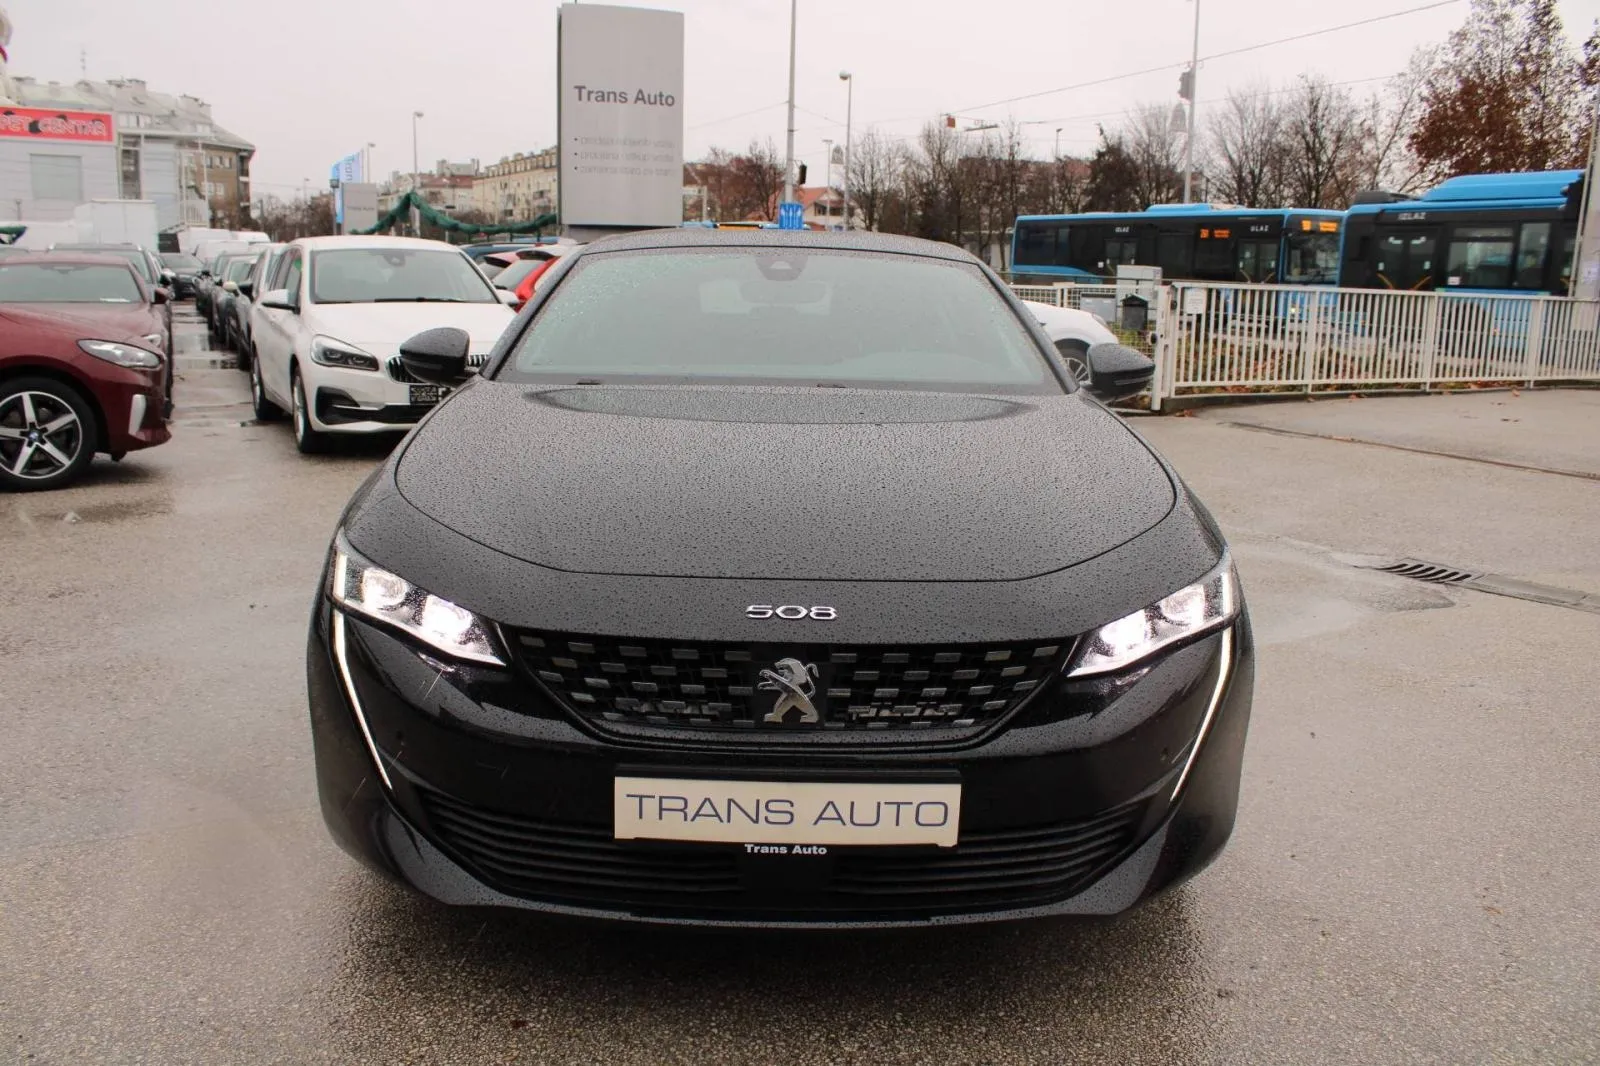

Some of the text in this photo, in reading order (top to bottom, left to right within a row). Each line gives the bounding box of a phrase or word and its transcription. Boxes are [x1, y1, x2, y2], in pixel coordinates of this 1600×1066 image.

[574, 85, 675, 107] Trans Auto
[39, 117, 107, 137] CENTAR
[745, 604, 838, 620] 508
[626, 794, 949, 827] TRANS AUTO
[744, 843, 828, 856] Trans Auto
